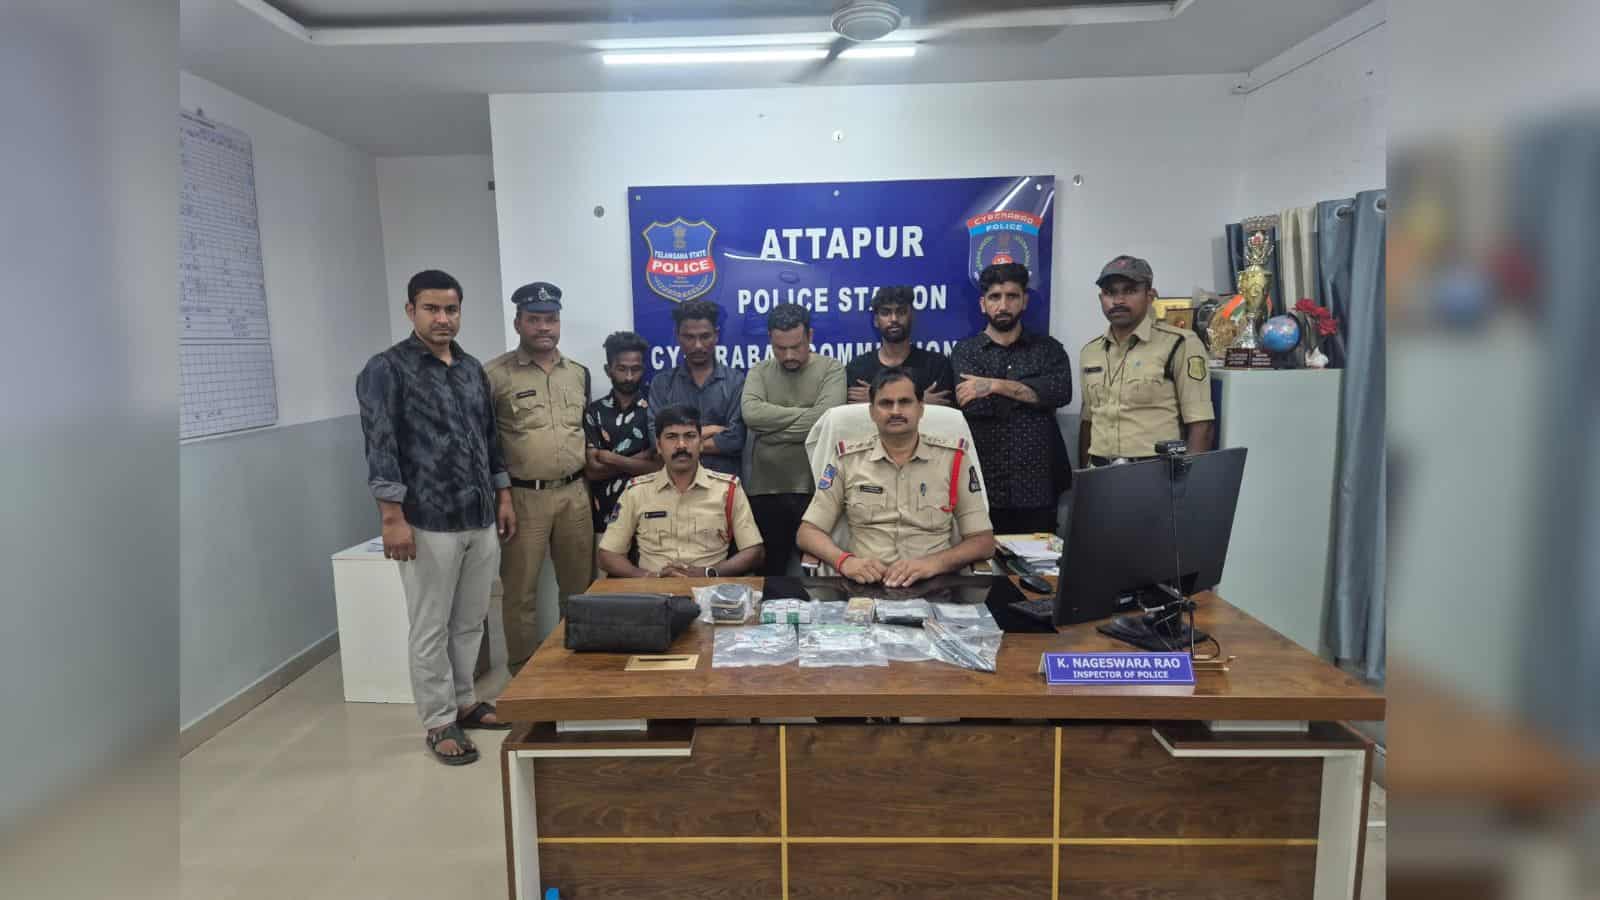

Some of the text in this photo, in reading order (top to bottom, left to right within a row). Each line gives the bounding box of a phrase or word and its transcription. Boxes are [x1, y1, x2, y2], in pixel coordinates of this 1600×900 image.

[986, 223, 1022, 232] POLICE
[760, 225, 924, 260] ATTAPUR
[652, 259, 711, 273] POLICE
[737, 284, 946, 314] POLICE STON
[650, 343, 776, 370] CYRABA
[1056, 657, 1181, 669] K. NAGESWARA RAO
[1073, 670, 1169, 679] INSPECTOR OF POLICE
